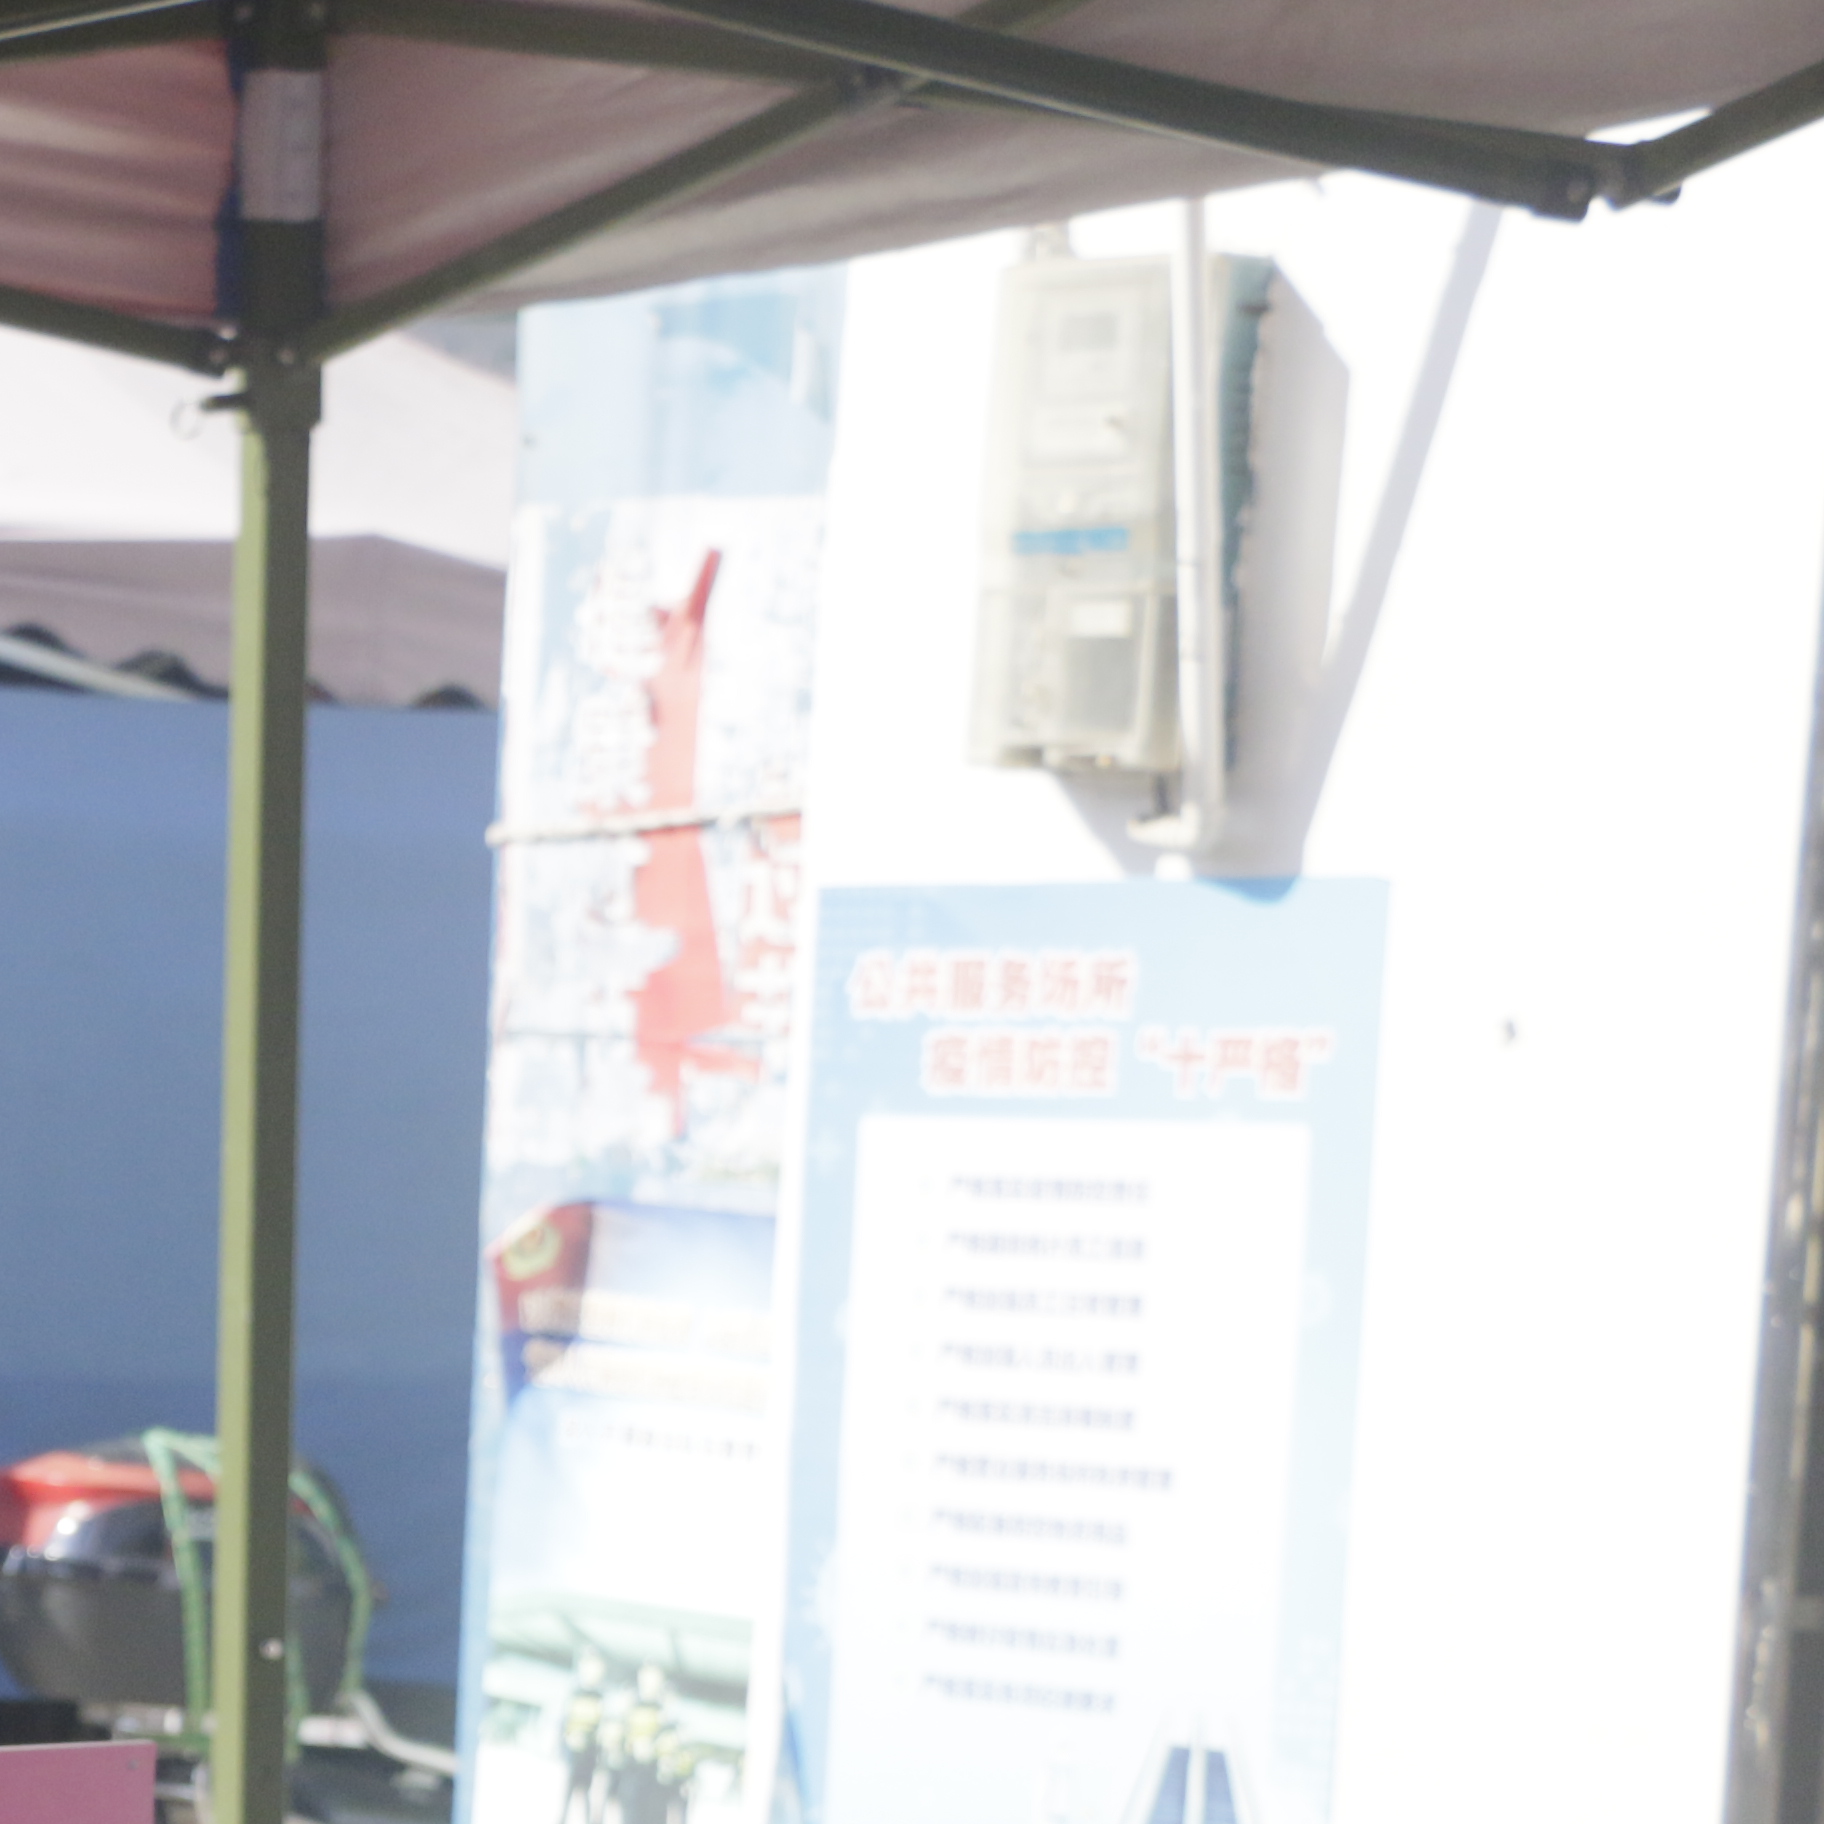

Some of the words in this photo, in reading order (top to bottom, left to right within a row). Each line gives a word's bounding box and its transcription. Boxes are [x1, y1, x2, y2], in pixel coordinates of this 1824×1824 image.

[848, 950, 1136, 1016] 公共服务场所
